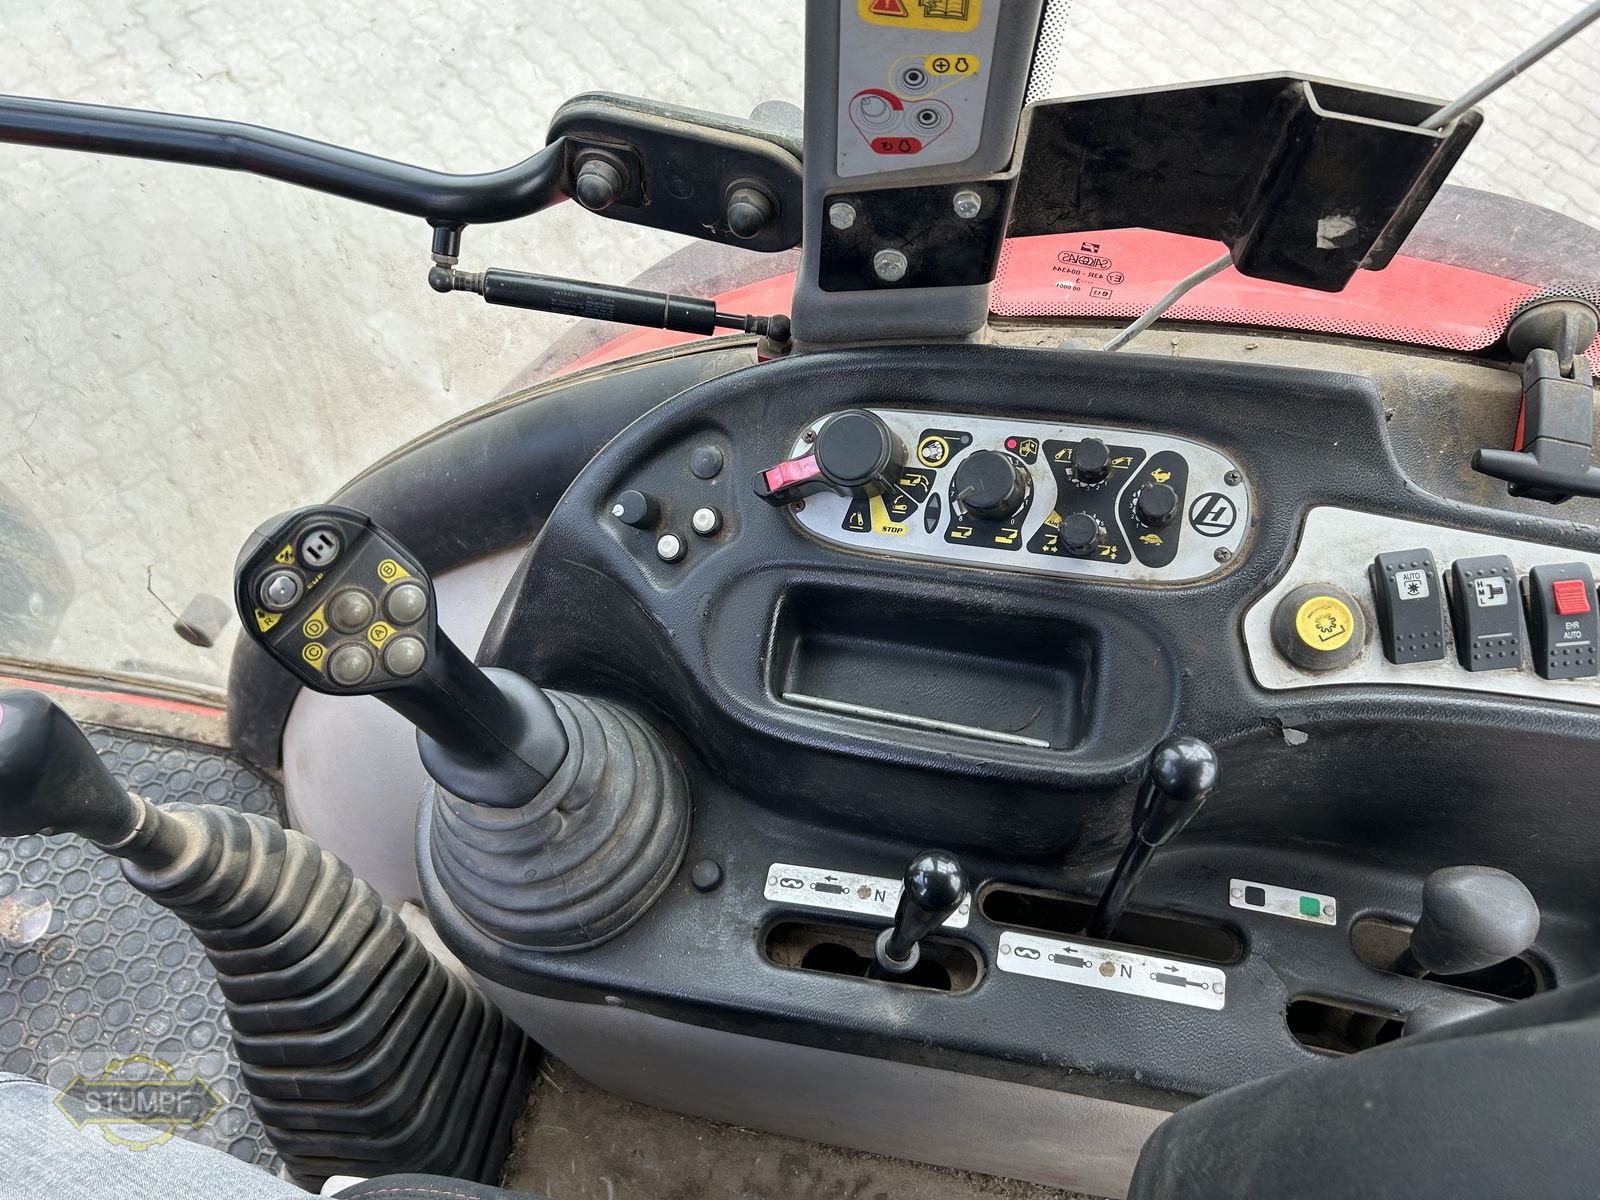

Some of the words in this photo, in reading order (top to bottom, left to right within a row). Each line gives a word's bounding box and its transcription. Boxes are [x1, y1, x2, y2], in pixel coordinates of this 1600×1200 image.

[881, 525, 904, 534] STOP
[383, 565, 393, 575] B
[1403, 572, 1421, 580] AUTO
[264, 617, 274, 626] R
[1565, 621, 1580, 630] EHR
[308, 623, 320, 633] D
[374, 629, 384, 638] A
[1563, 631, 1582, 639] AUTO
[308, 647, 319, 657] C
[874, 889, 886, 903] N
[1120, 964, 1133, 979] N
